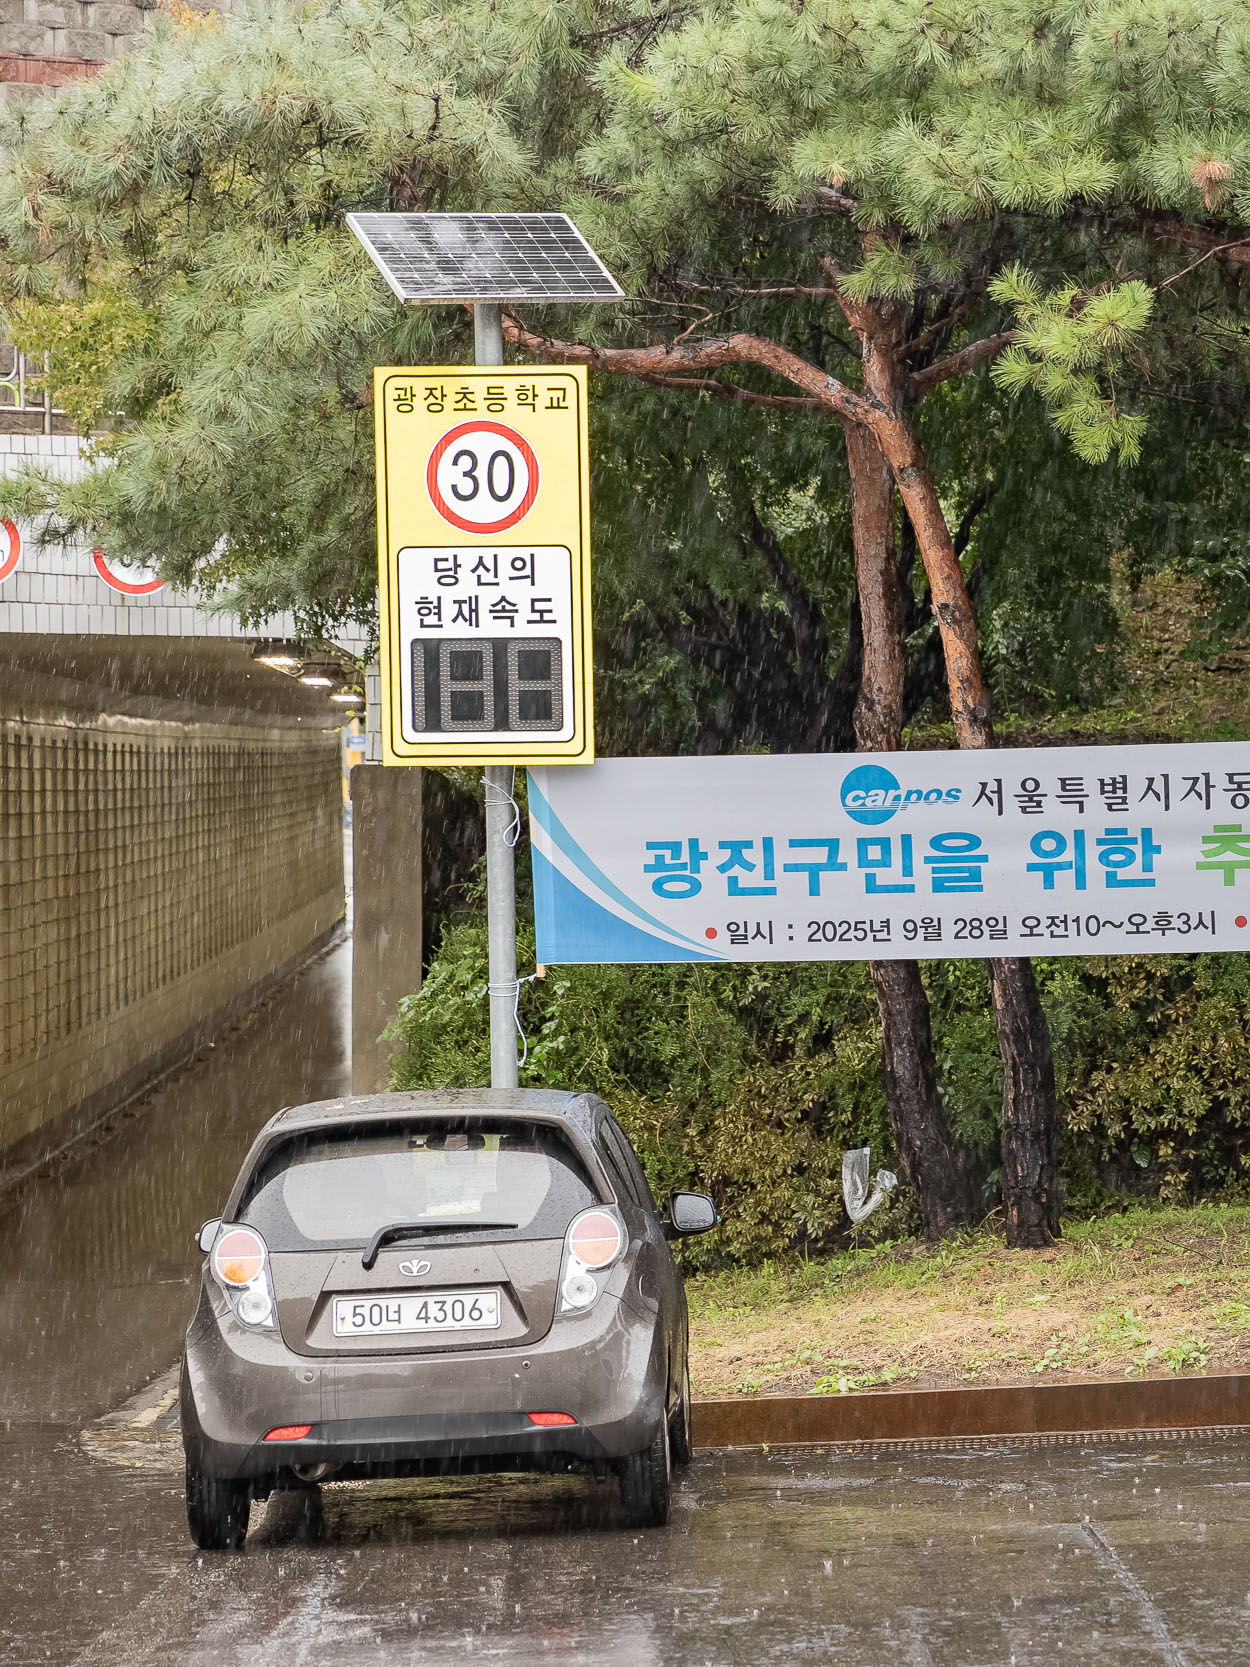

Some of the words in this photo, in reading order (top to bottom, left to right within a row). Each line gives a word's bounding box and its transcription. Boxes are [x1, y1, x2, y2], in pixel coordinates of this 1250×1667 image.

[393, 384, 569, 413] 광장초등학교
[451, 450, 515, 502] 30
[434, 553, 535, 586] 당신의
[415, 595, 557, 628] 현재속도
[844, 787, 963, 812] carpos
[644, 832, 988, 899] 광진구민을
[1027, 828, 1161, 890] 위한
[727, 921, 773, 944] 일시
[808, 919, 891, 942] 2025년
[903, 917, 942, 941] 9월
[954, 916, 1008, 940] 28일
[1020, 911, 1215, 938] 오전10~오후3시
[351, 1303, 402, 1328] 50너
[415, 1298, 484, 1324] 4306
